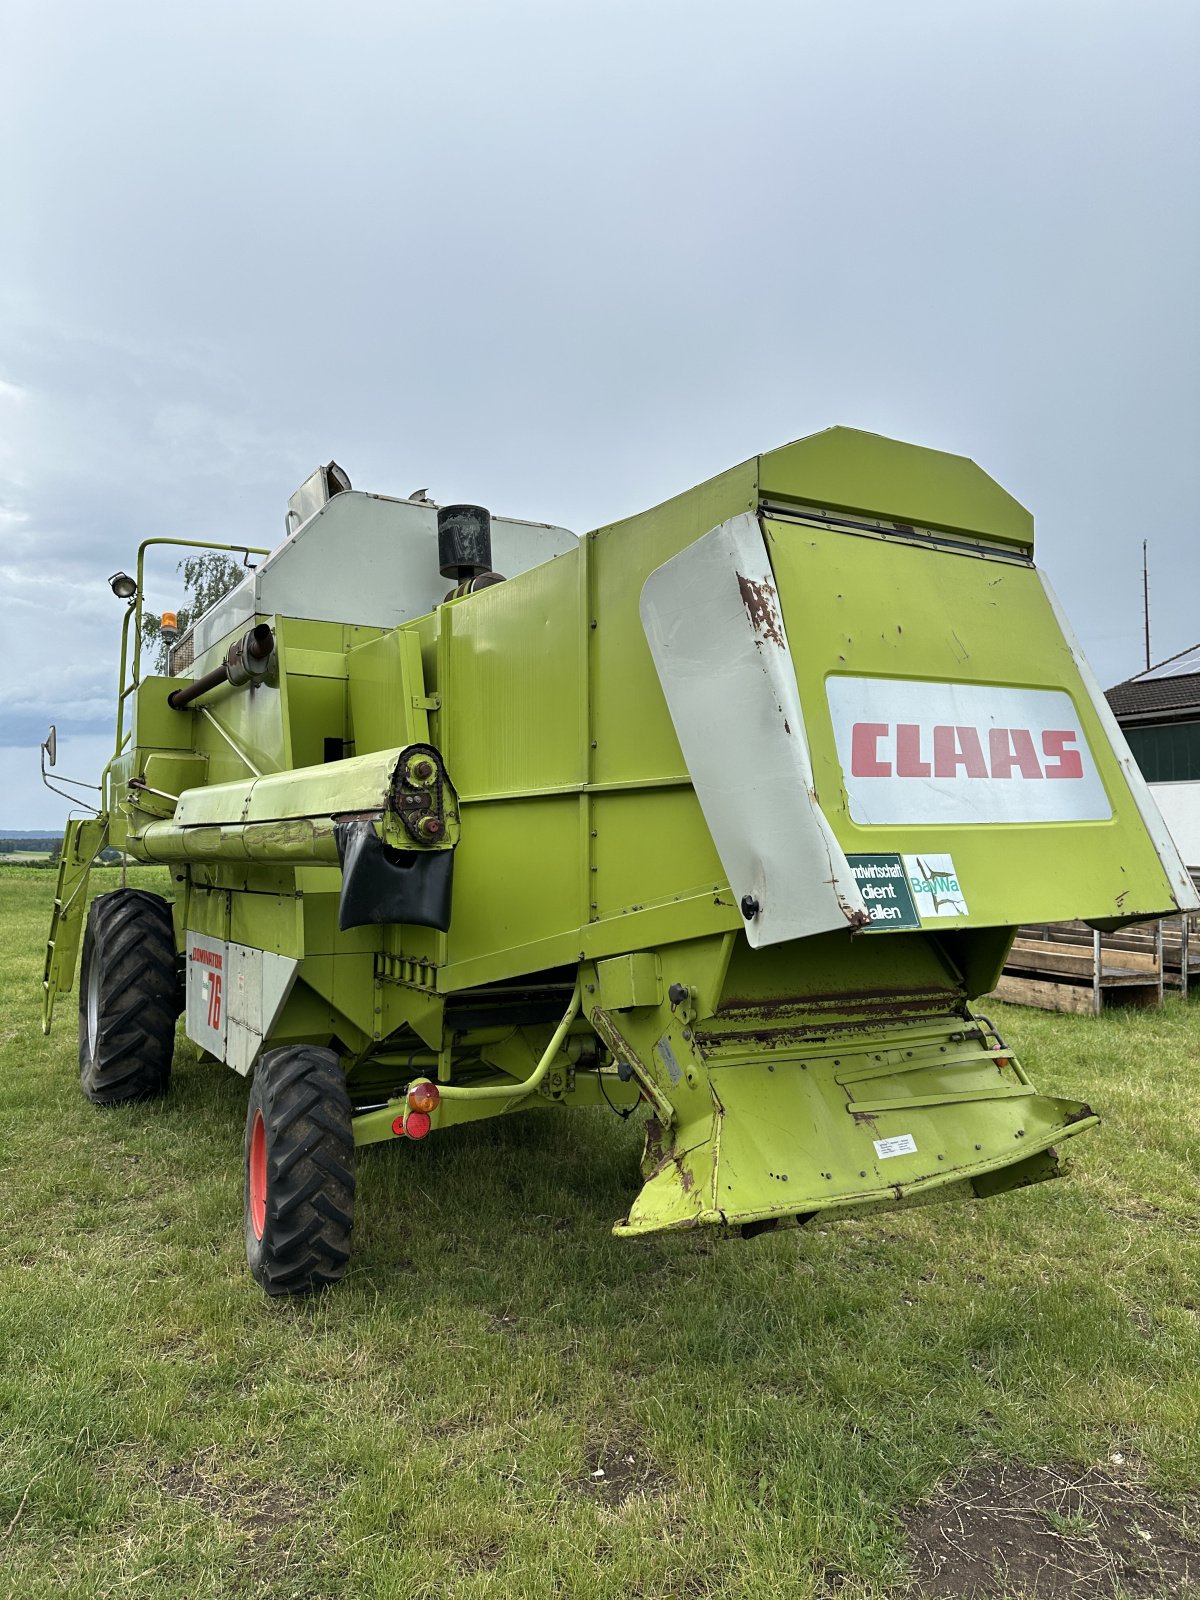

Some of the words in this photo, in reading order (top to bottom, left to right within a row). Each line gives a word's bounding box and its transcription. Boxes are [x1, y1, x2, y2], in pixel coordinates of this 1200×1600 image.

[851, 722, 1083, 779] CLAAS
[850, 864, 903, 879] ndwirtschaft
[862, 883, 897, 899] dient
[910, 877, 959, 895] BayWa
[869, 904, 902, 919] allen
[192, 947, 222, 970] DOMINATOR
[208, 972, 222, 1030] 76
